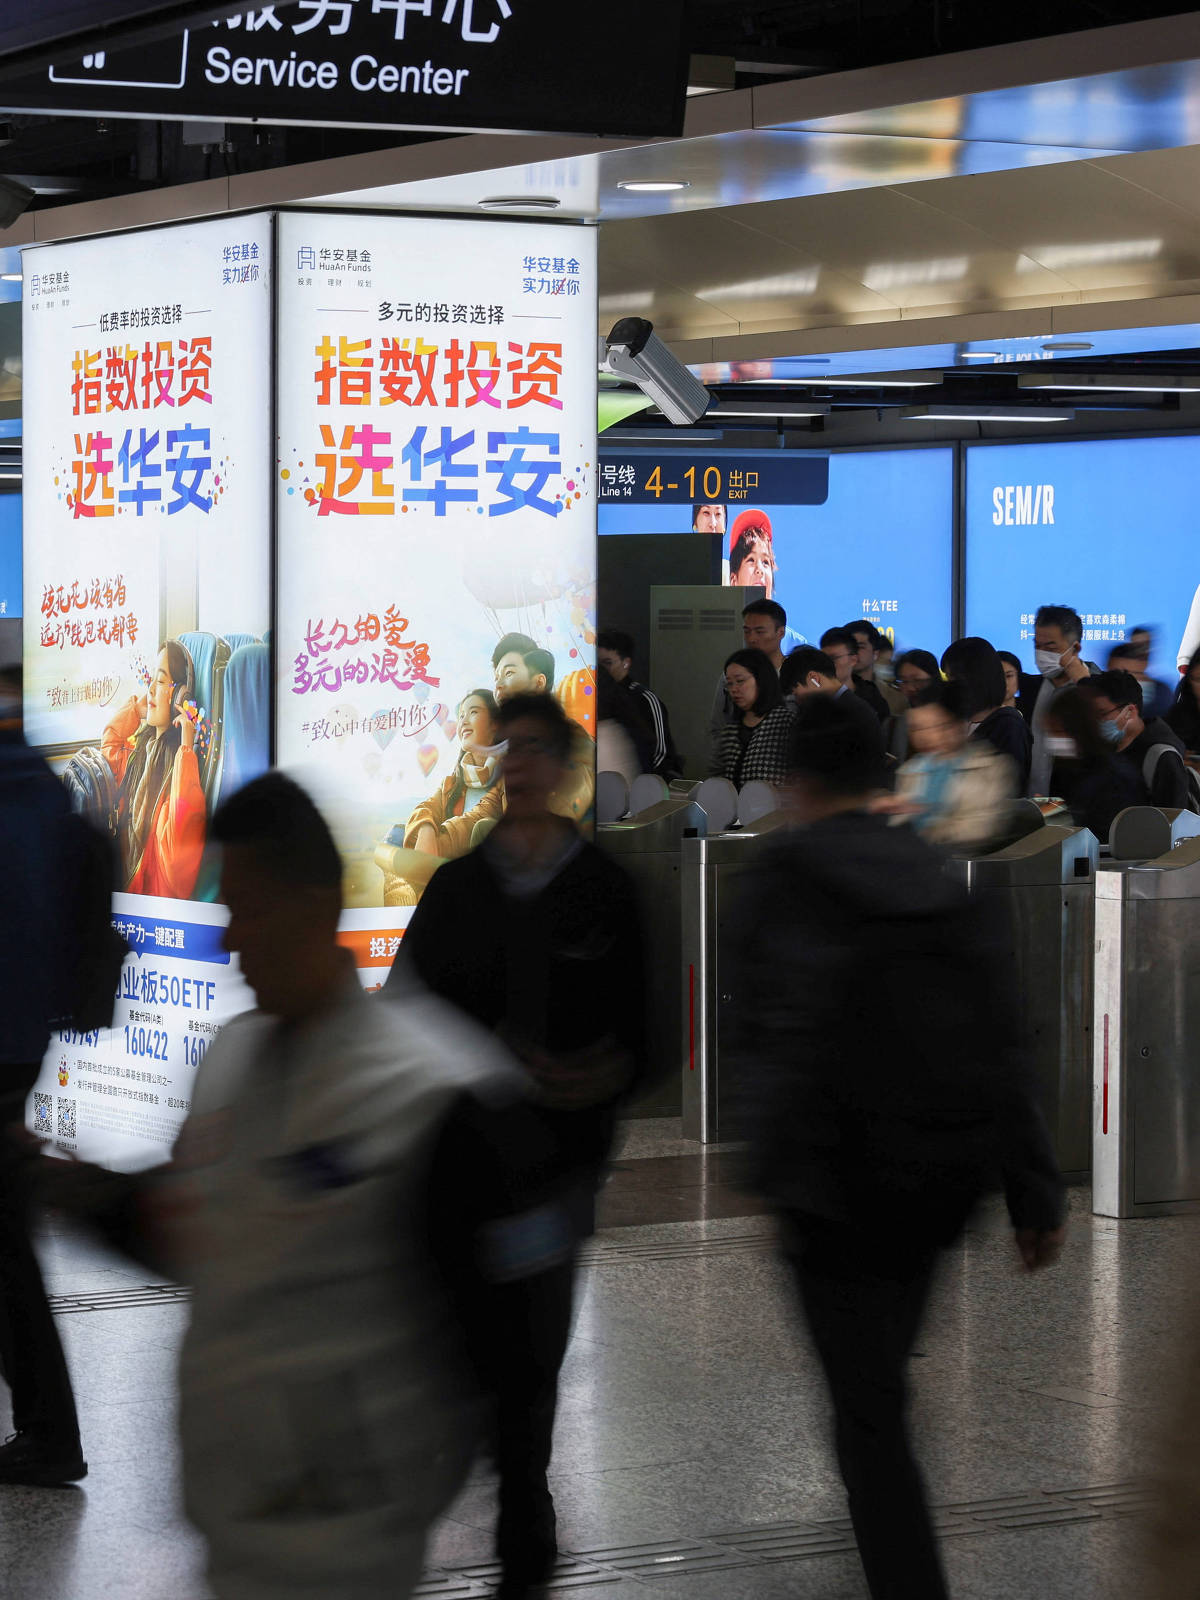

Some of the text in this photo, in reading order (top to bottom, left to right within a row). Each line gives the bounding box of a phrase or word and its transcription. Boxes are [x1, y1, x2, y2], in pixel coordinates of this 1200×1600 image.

[205, 46, 469, 96] Service Center
[223, 242, 259, 263] 华安基金
[319, 248, 372, 263] 华安基金
[319, 262, 372, 272] HuaAn Funds
[523, 256, 580, 275] 华安基金
[41, 271, 69, 285] 华安基金
[222, 264, 260, 285] 实力挺你
[522, 277, 580, 296] 实力挺你
[99, 304, 183, 333] 低费率的投资选择
[378, 301, 505, 325] 多元的投资选择
[71, 335, 212, 416] 指数投资
[314, 335, 563, 410] 指数投资
[71, 422, 211, 520] 选华安
[315, 423, 562, 519] 选华安
[601, 465, 635, 486] 号线
[644, 466, 722, 499] 4-10
[729, 469, 759, 489] 出口
[601, 487, 632, 497] Line 14
[728, 490, 749, 500] EXIT
[304, 603, 416, 657] 长久的爱
[292, 643, 440, 694] 多元的浪漫
[302, 704, 428, 741] #致心中有爱的你
[115, 966, 216, 1011] 业板50ETF
[124, 1025, 168, 1061] 160422
[183, 1035, 213, 1067] 160
